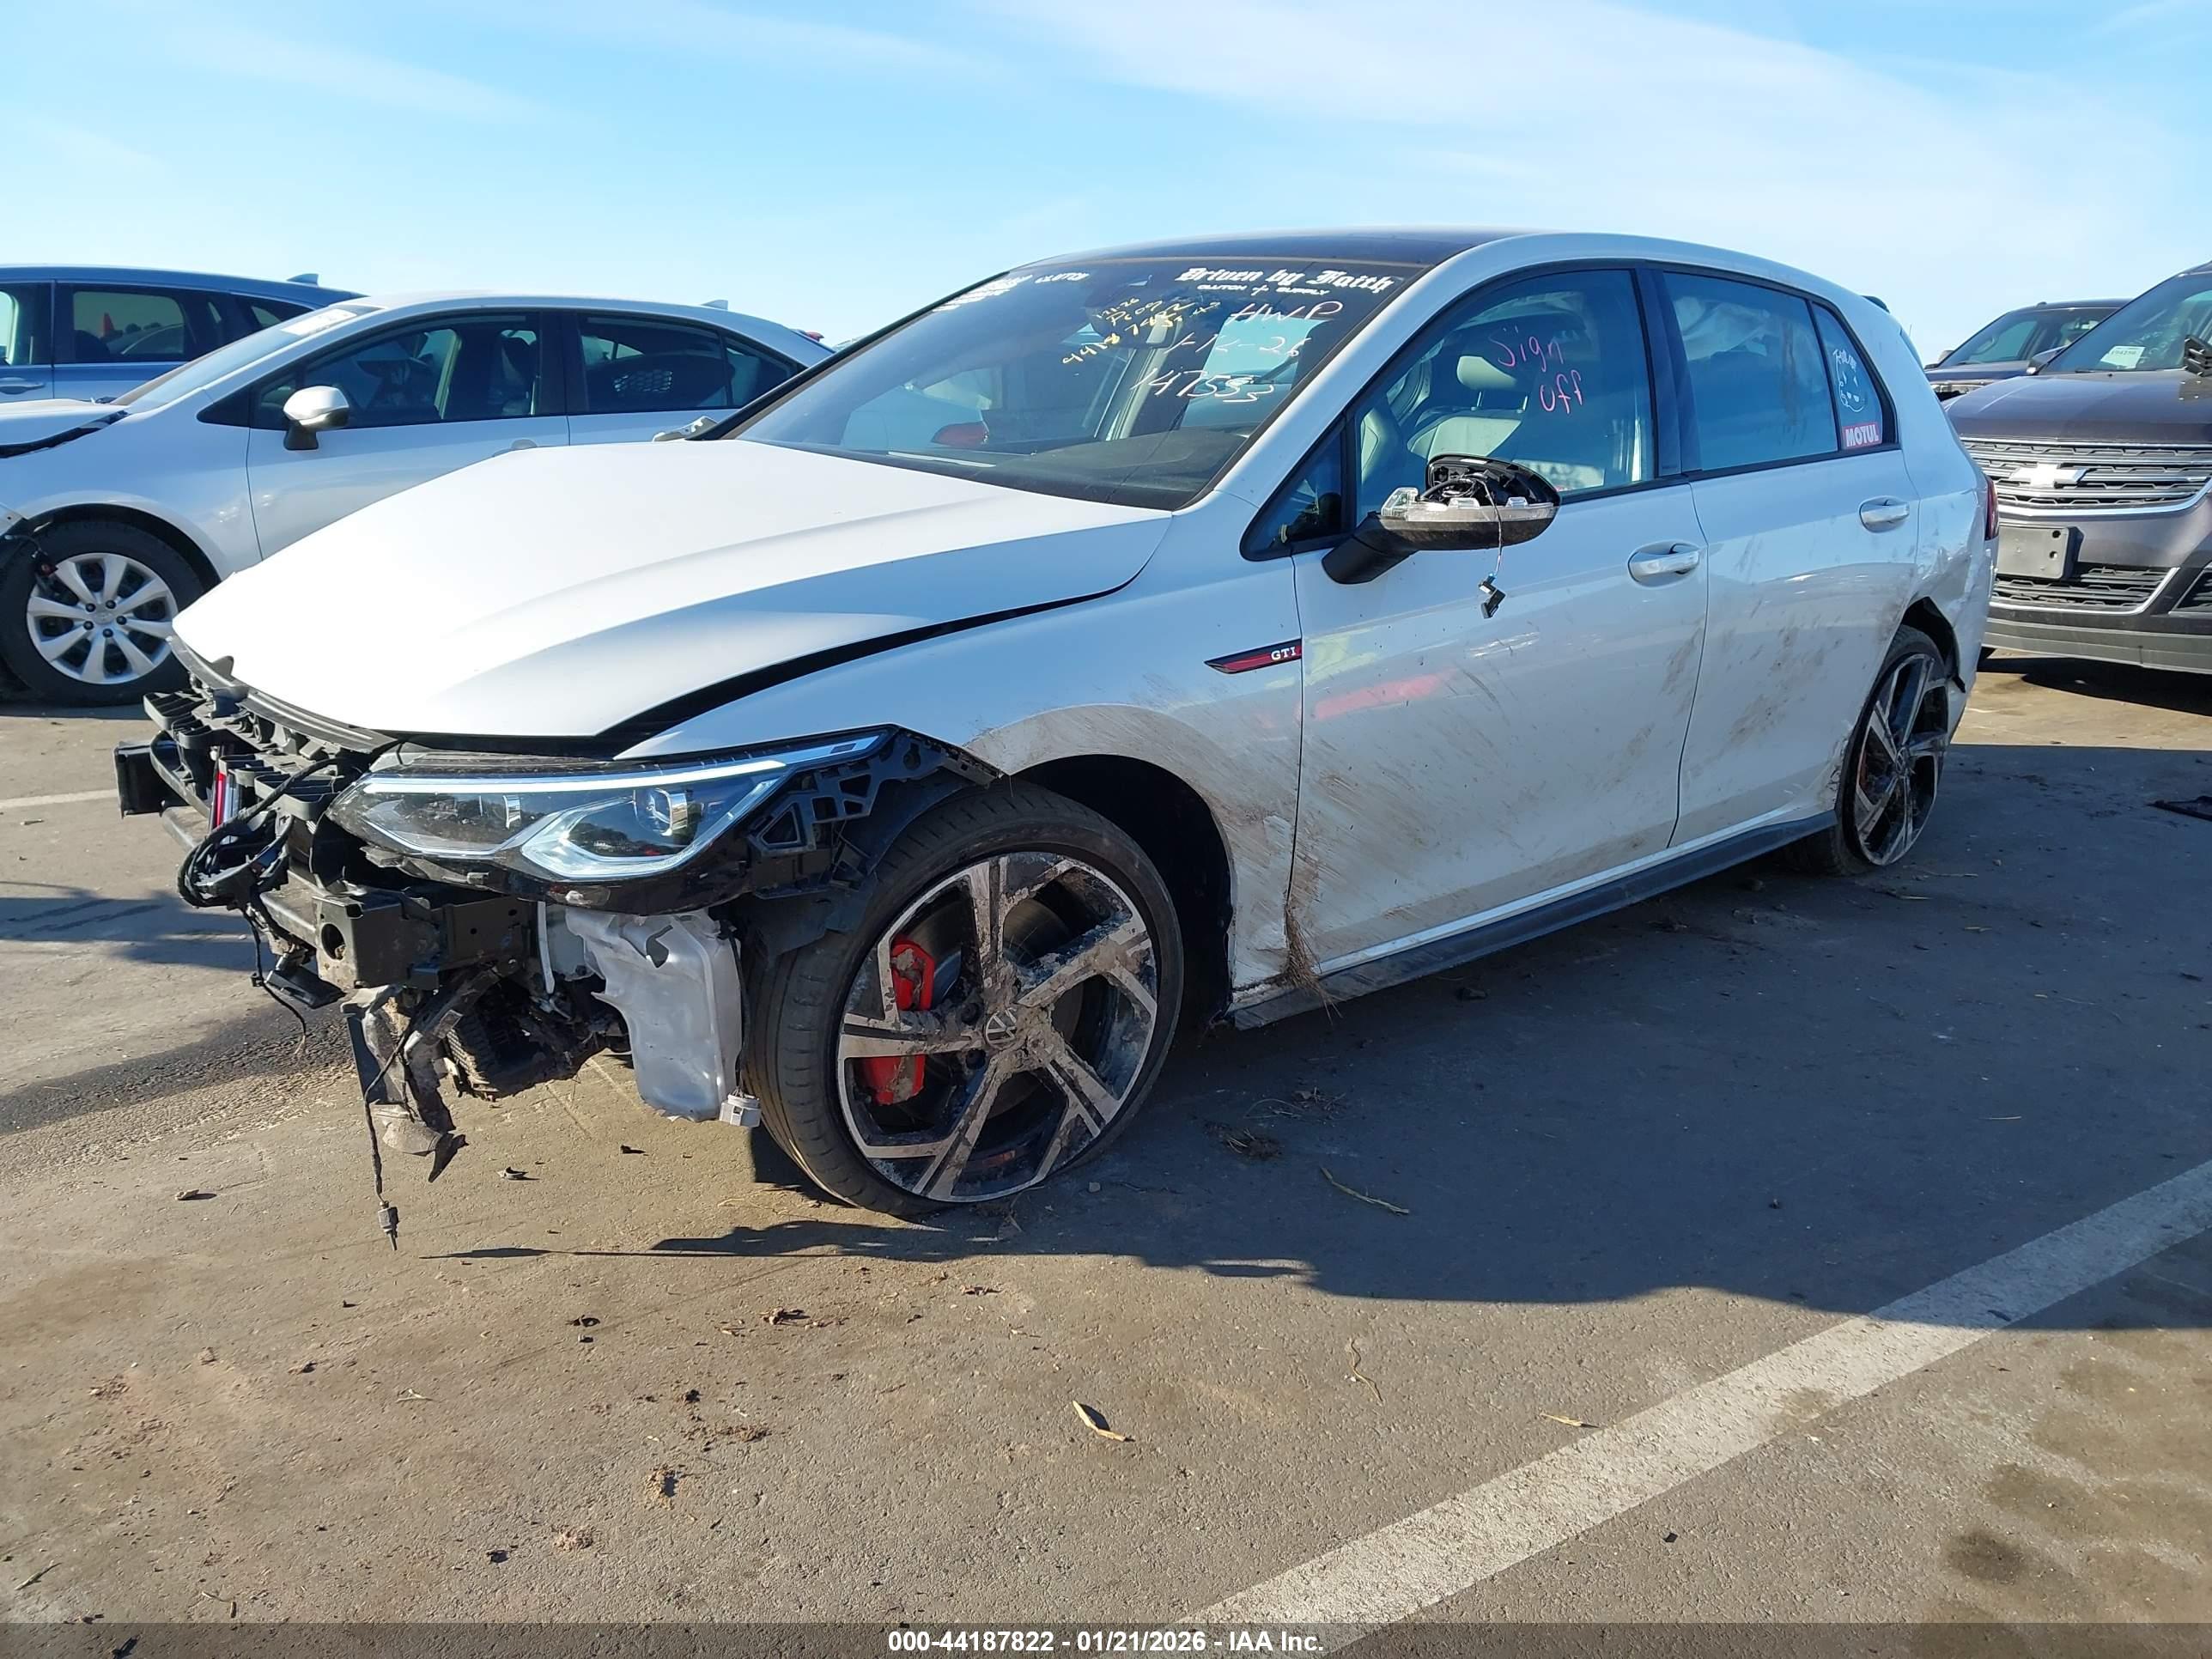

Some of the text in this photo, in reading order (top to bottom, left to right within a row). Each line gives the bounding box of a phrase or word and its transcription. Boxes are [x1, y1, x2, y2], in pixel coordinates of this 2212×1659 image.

[1175, 267, 1395, 294] Driven by Faith
[1275, 286, 1330, 295] SUPPLY
[1845, 424, 1879, 447] MOTUL
[1271, 647, 1296, 660] GTI
